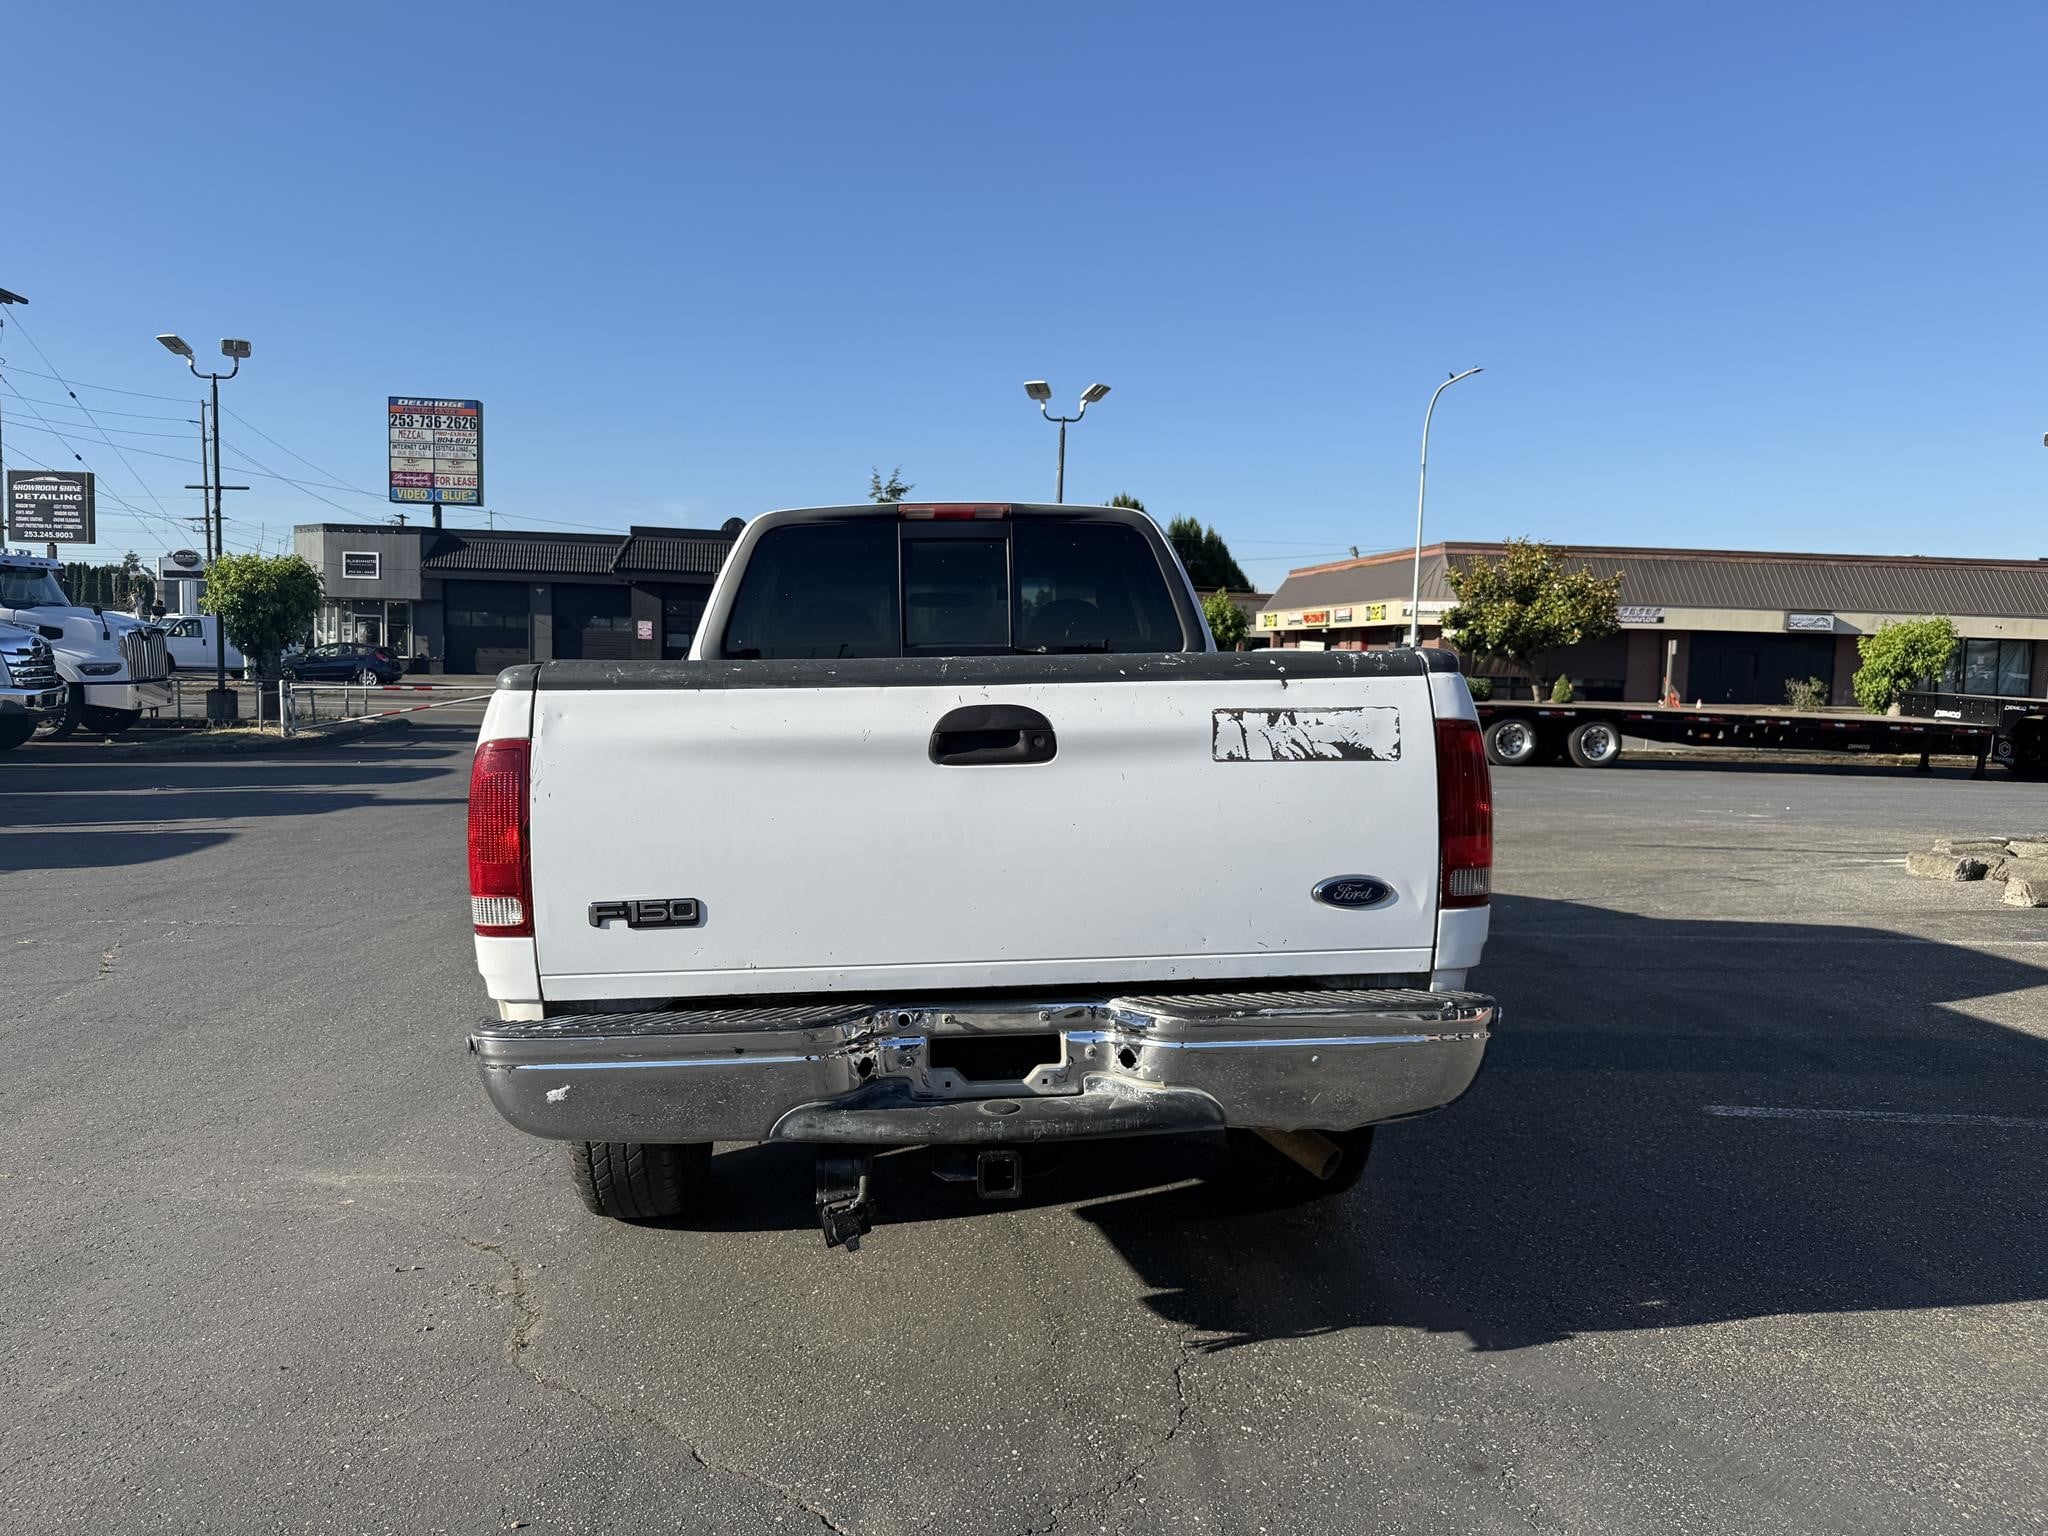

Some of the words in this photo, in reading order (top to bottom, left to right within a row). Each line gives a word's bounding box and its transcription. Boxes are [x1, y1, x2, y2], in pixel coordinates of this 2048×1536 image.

[397, 399, 465, 408] DELRIDGE
[391, 414, 476, 429] 253-736-2626
[398, 429, 425, 439] MEZCAL
[435, 476, 451, 485] FOR
[453, 477, 476, 486] LEASE
[397, 488, 427, 499] VIDEO
[442, 490, 467, 500] BLUE
[1934, 710, 1961, 719] DEMCO
[1333, 883, 1373, 900] Ford
[588, 900, 698, 926] F-150
